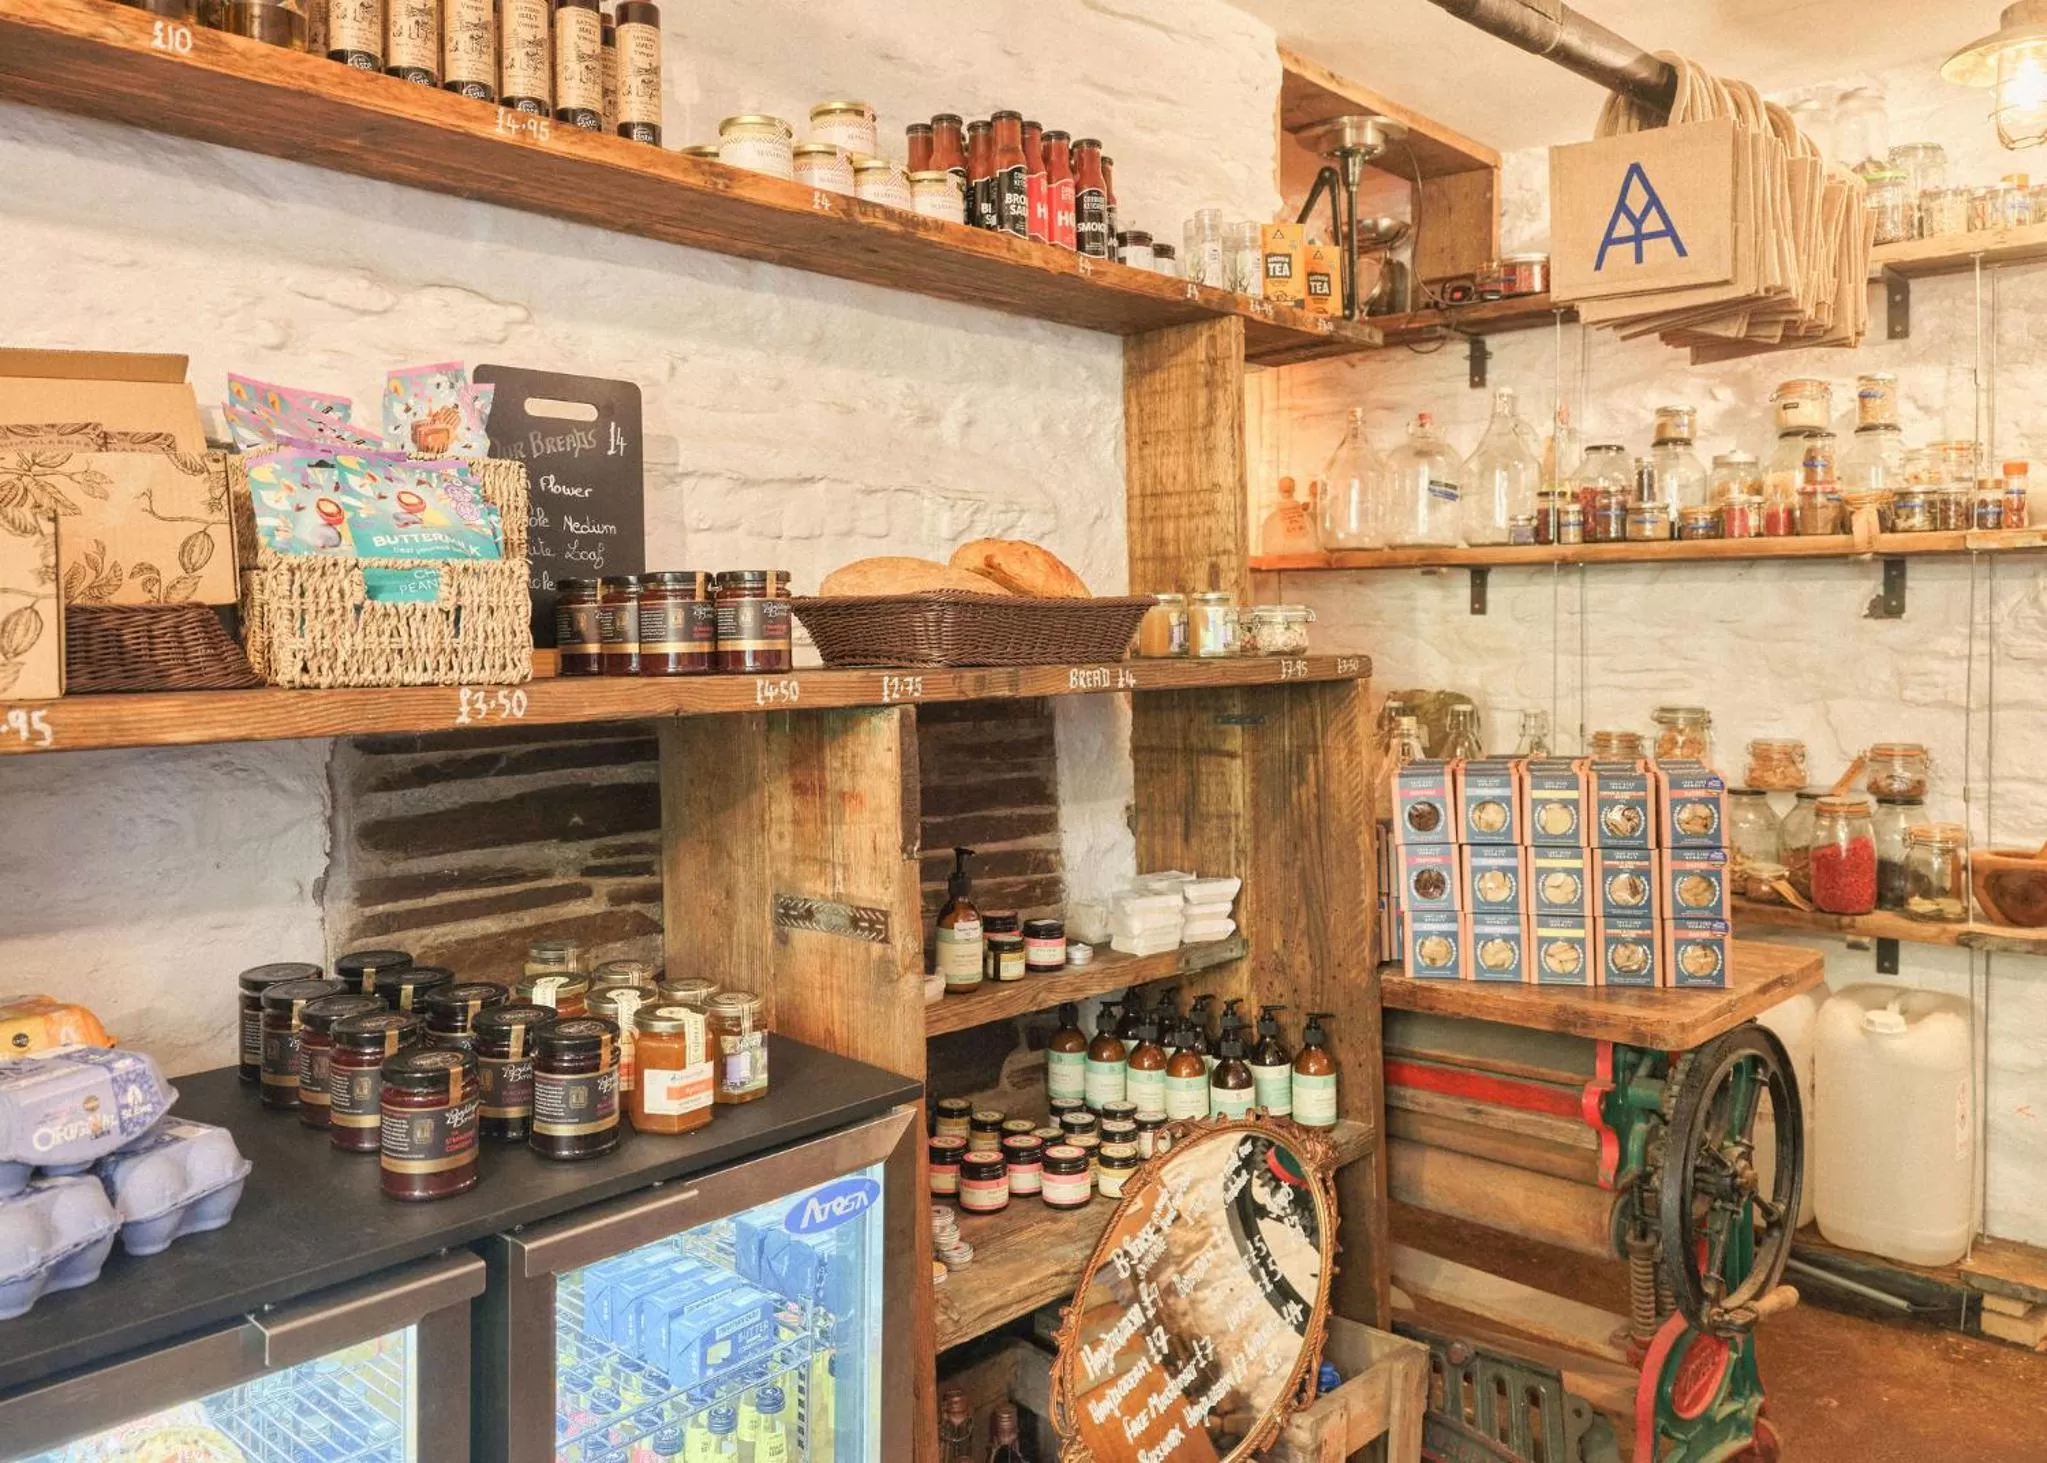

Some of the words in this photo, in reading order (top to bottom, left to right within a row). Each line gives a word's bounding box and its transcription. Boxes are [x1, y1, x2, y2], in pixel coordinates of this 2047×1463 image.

[150, 20, 194, 54] £10
[812, 190, 832, 210] £4
[1268, 262, 1291, 277] TEA
[1310, 281, 1330, 295] TEA
[606, 420, 628, 457] £4
[1069, 666, 1111, 689] BREAD
[1117, 668, 1137, 688] £4
